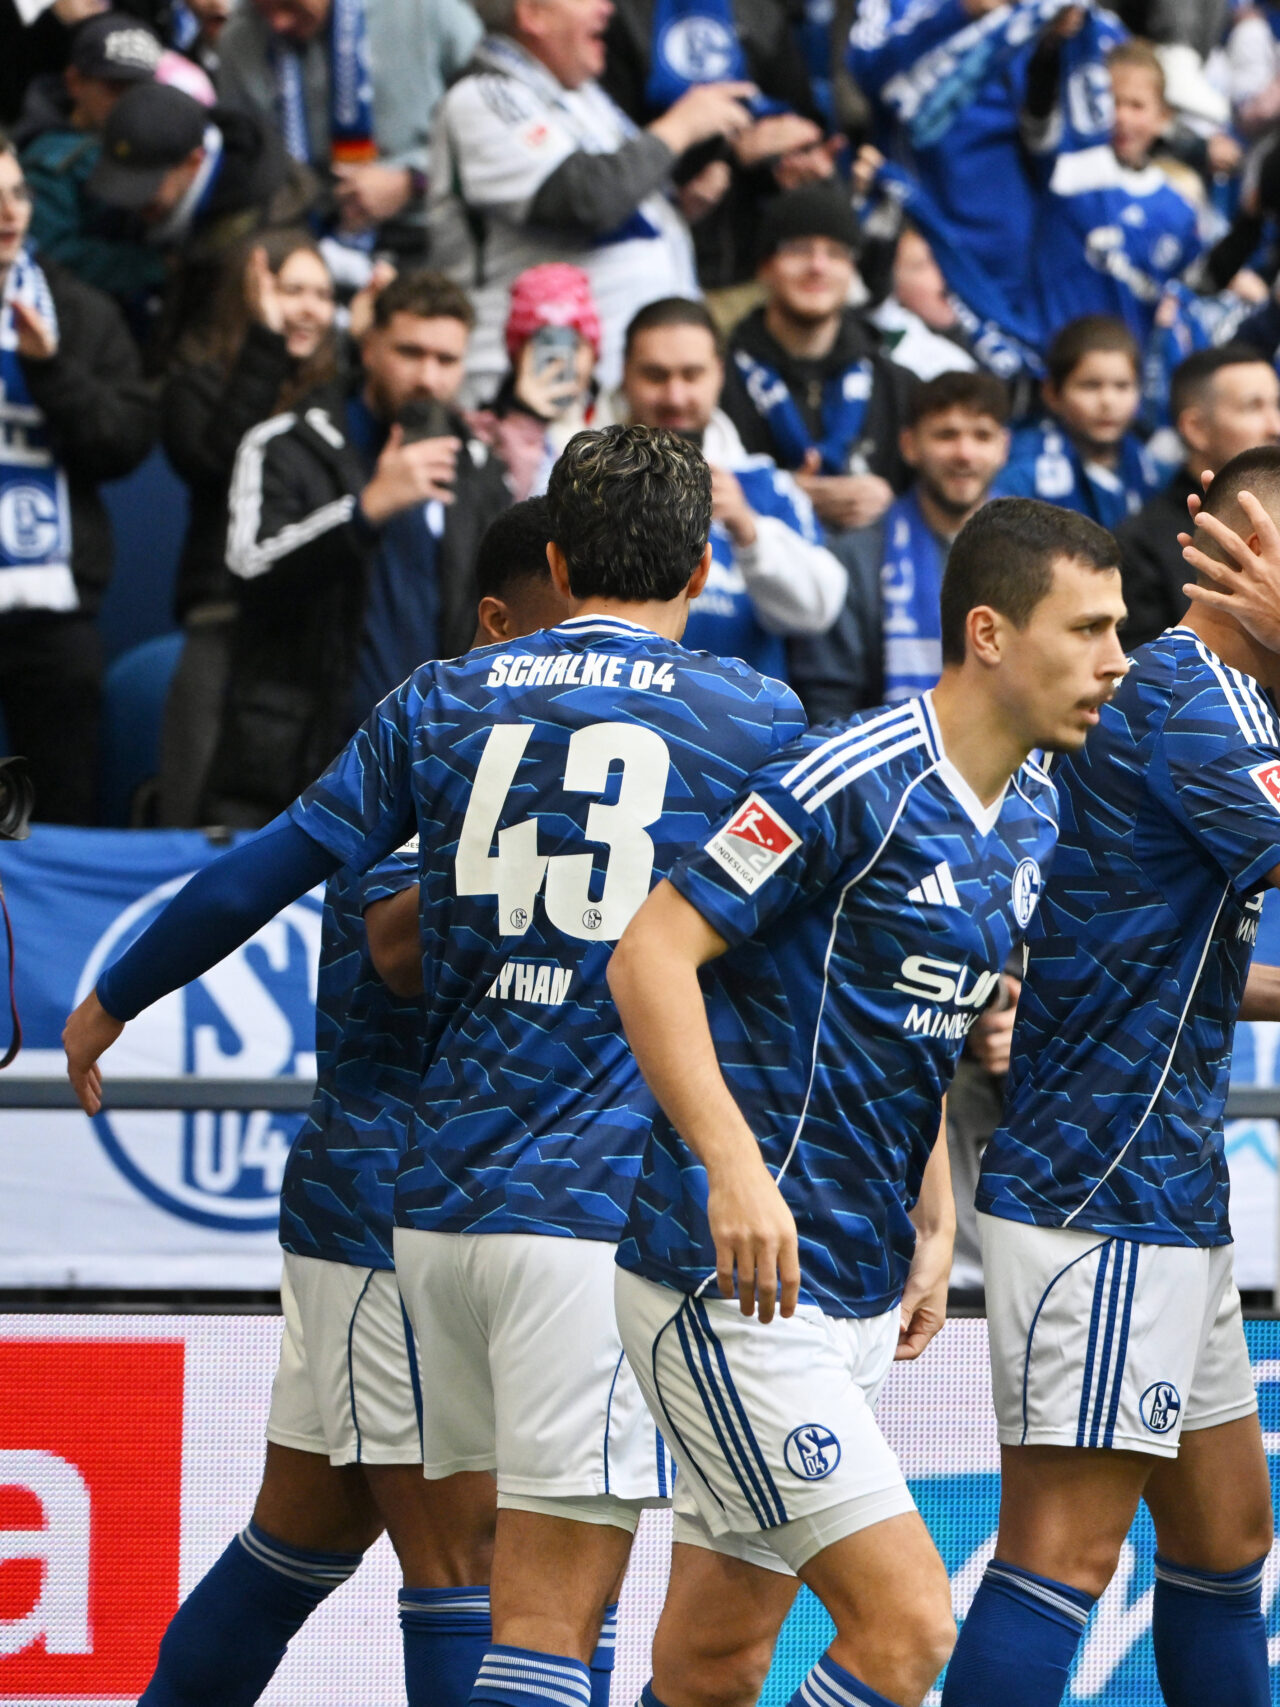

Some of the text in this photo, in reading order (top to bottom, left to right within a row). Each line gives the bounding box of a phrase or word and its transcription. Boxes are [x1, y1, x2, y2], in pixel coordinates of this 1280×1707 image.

[487, 653, 676, 693] SCHALKE 04
[455, 722, 670, 941] 43
